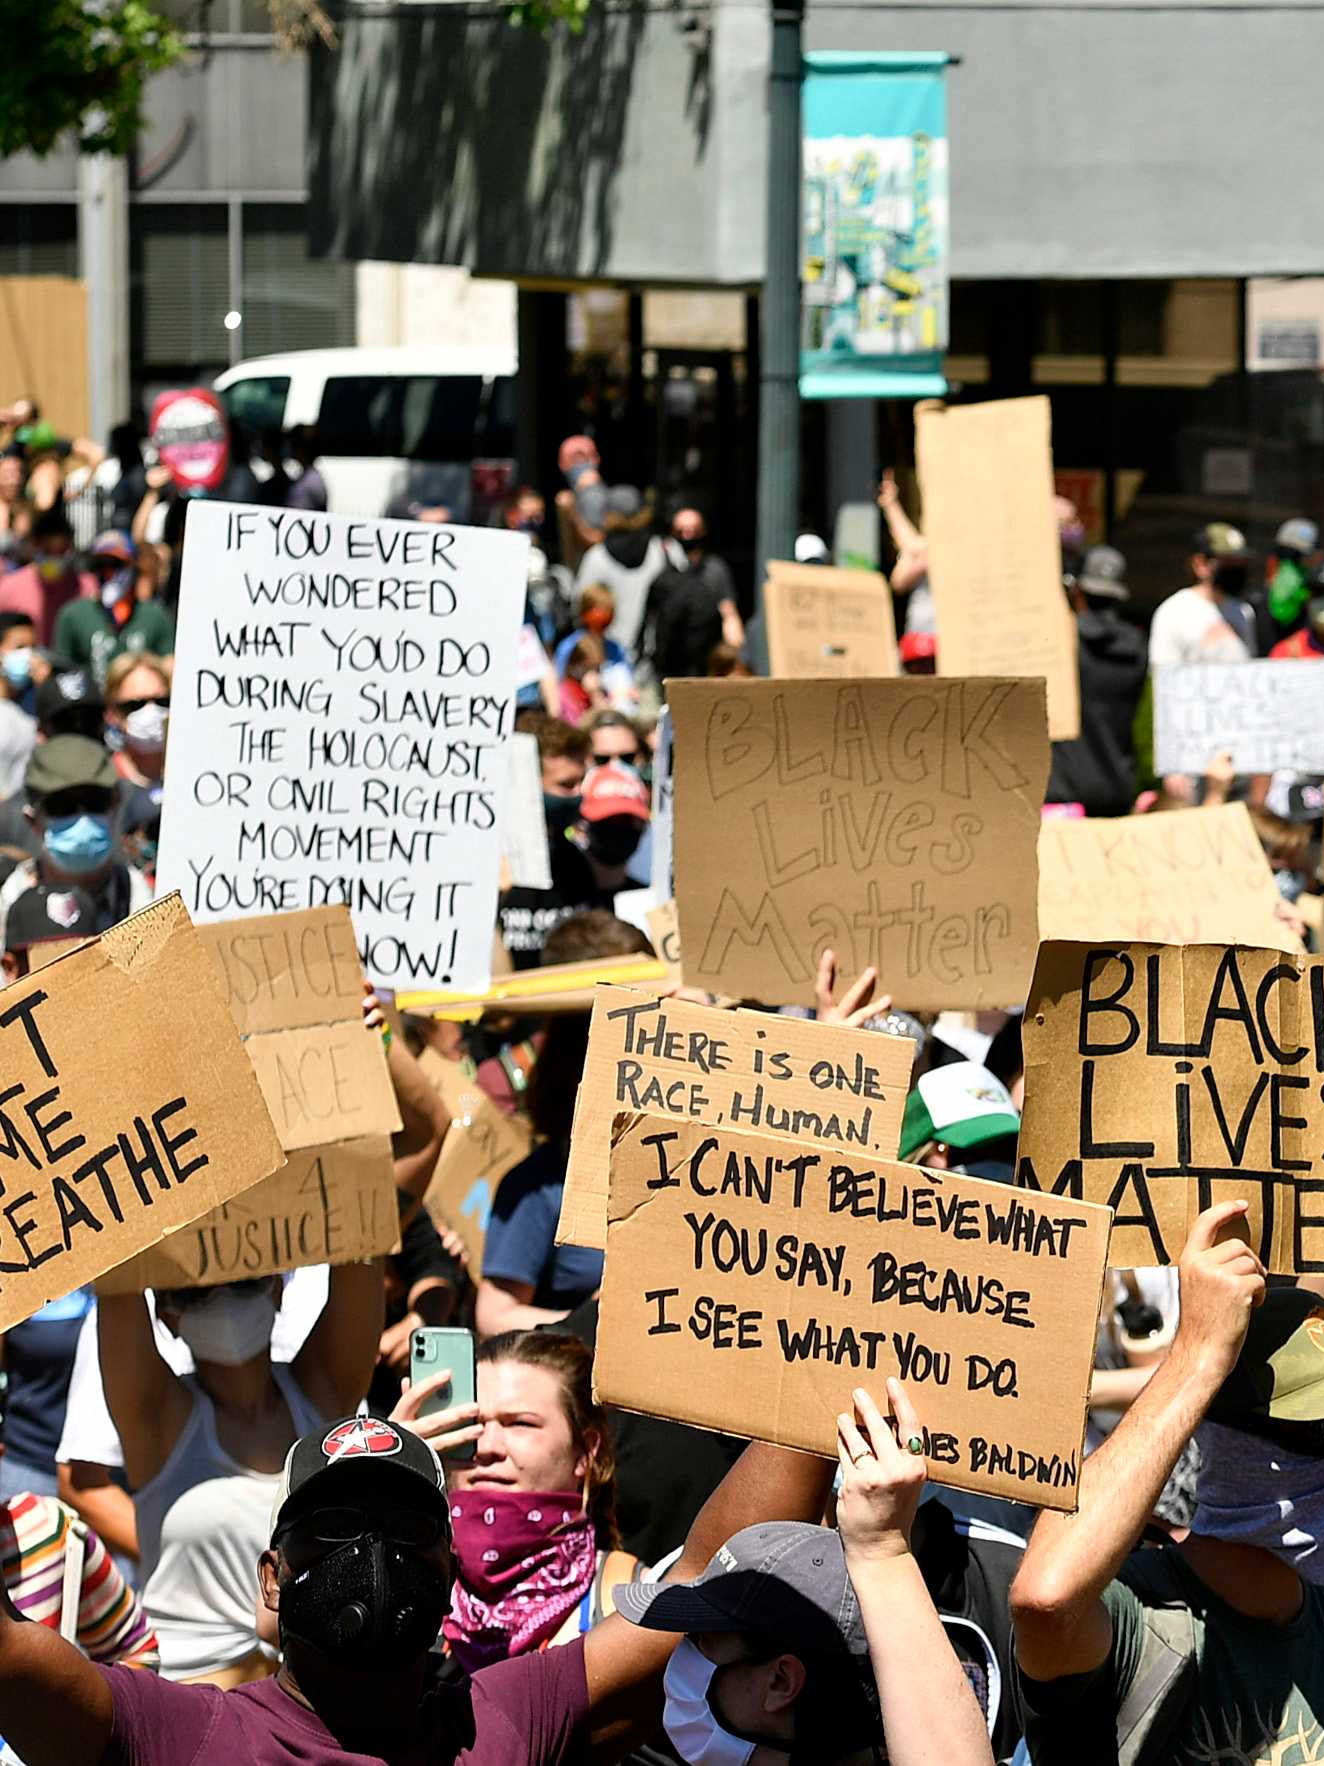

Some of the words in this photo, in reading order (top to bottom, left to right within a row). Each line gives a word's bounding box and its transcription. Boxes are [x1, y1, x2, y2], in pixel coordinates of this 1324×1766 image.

[226, 512, 260, 550] IF
[268, 513, 331, 559] YOU
[347, 524, 457, 571] EVER
[244, 573, 457, 618] WONDERED
[213, 619, 311, 658] WHAT
[437, 638, 490, 678] DO
[196, 669, 332, 717] DURING
[359, 683, 510, 741] SLAVERY,
[230, 722, 287, 763] THE
[704, 681, 1031, 801] BLACK
[193, 771, 252, 808] OR
[267, 776, 350, 815] CIVIL
[362, 778, 496, 830] RIGHTS
[238, 820, 447, 864] MOVEMENT
[309, 874, 416, 922] DOING
[435, 881, 473, 922] IT
[697, 879, 1012, 985] Matter
[607, 996, 733, 1074] THERE
[808, 1052, 887, 1102] ONE
[640, 1131, 681, 1191] I
[688, 1136, 822, 1208] CAN'T
[827, 1164, 981, 1240] BELIEVE
[985, 1200, 1087, 1258] WHAT
[683, 1211, 768, 1276] YOU
[774, 1234, 852, 1297] SAY,
[868, 1252, 1036, 1329] BECAUSE
[644, 1288, 682, 1336] I
[687, 1295, 763, 1349] SEE
[777, 1318, 887, 1370] WHAT
[892, 1330, 951, 1386] YOU
[921, 1425, 961, 1465] ES
[968, 1435, 1078, 1489] BALDWIN
